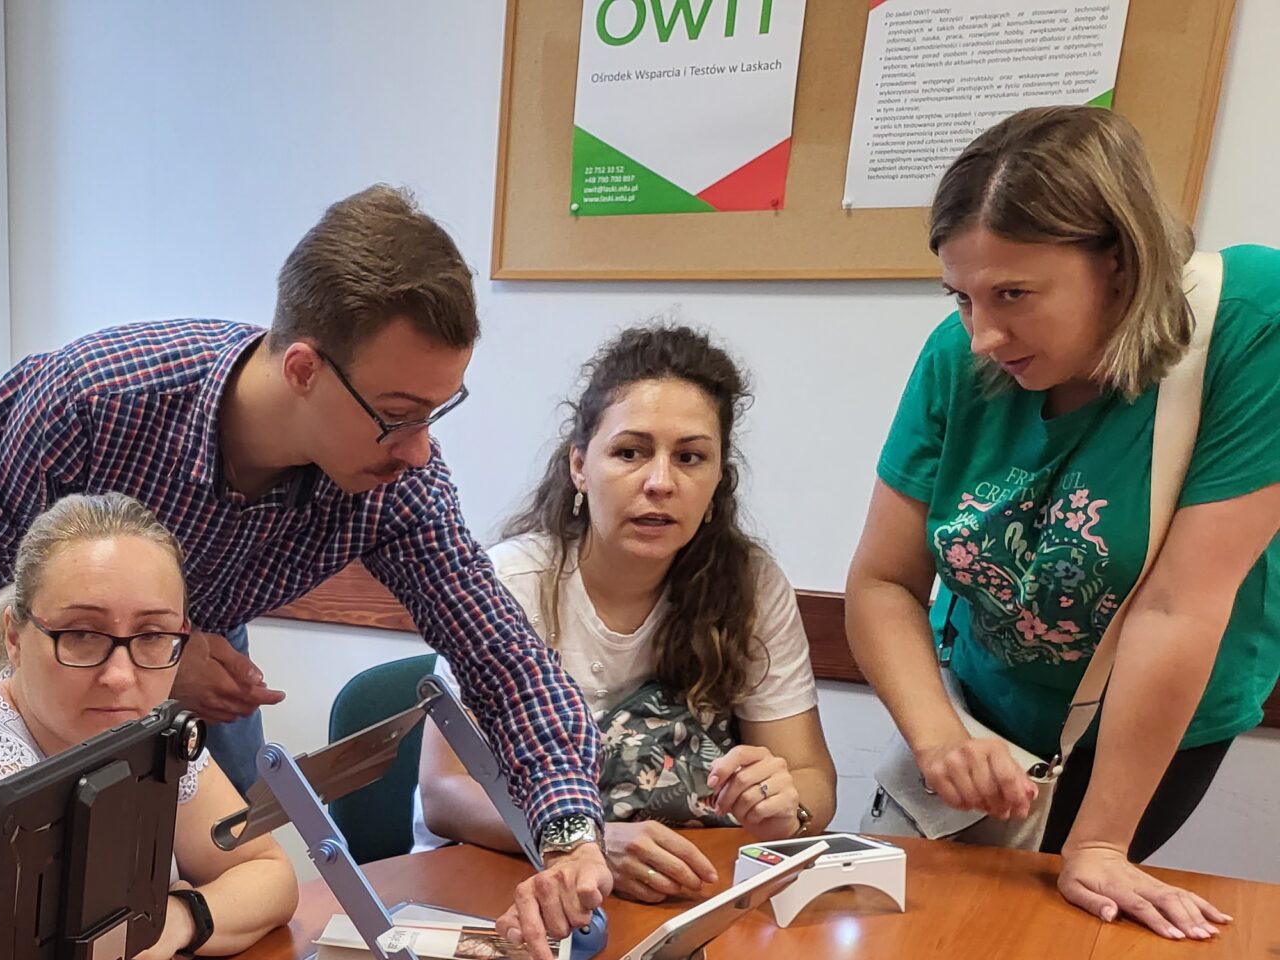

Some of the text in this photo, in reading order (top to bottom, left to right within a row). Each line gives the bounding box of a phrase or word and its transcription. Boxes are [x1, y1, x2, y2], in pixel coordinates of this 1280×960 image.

[591, 59, 782, 84] Ośrodek Wsparcia i Testów w Laskach
